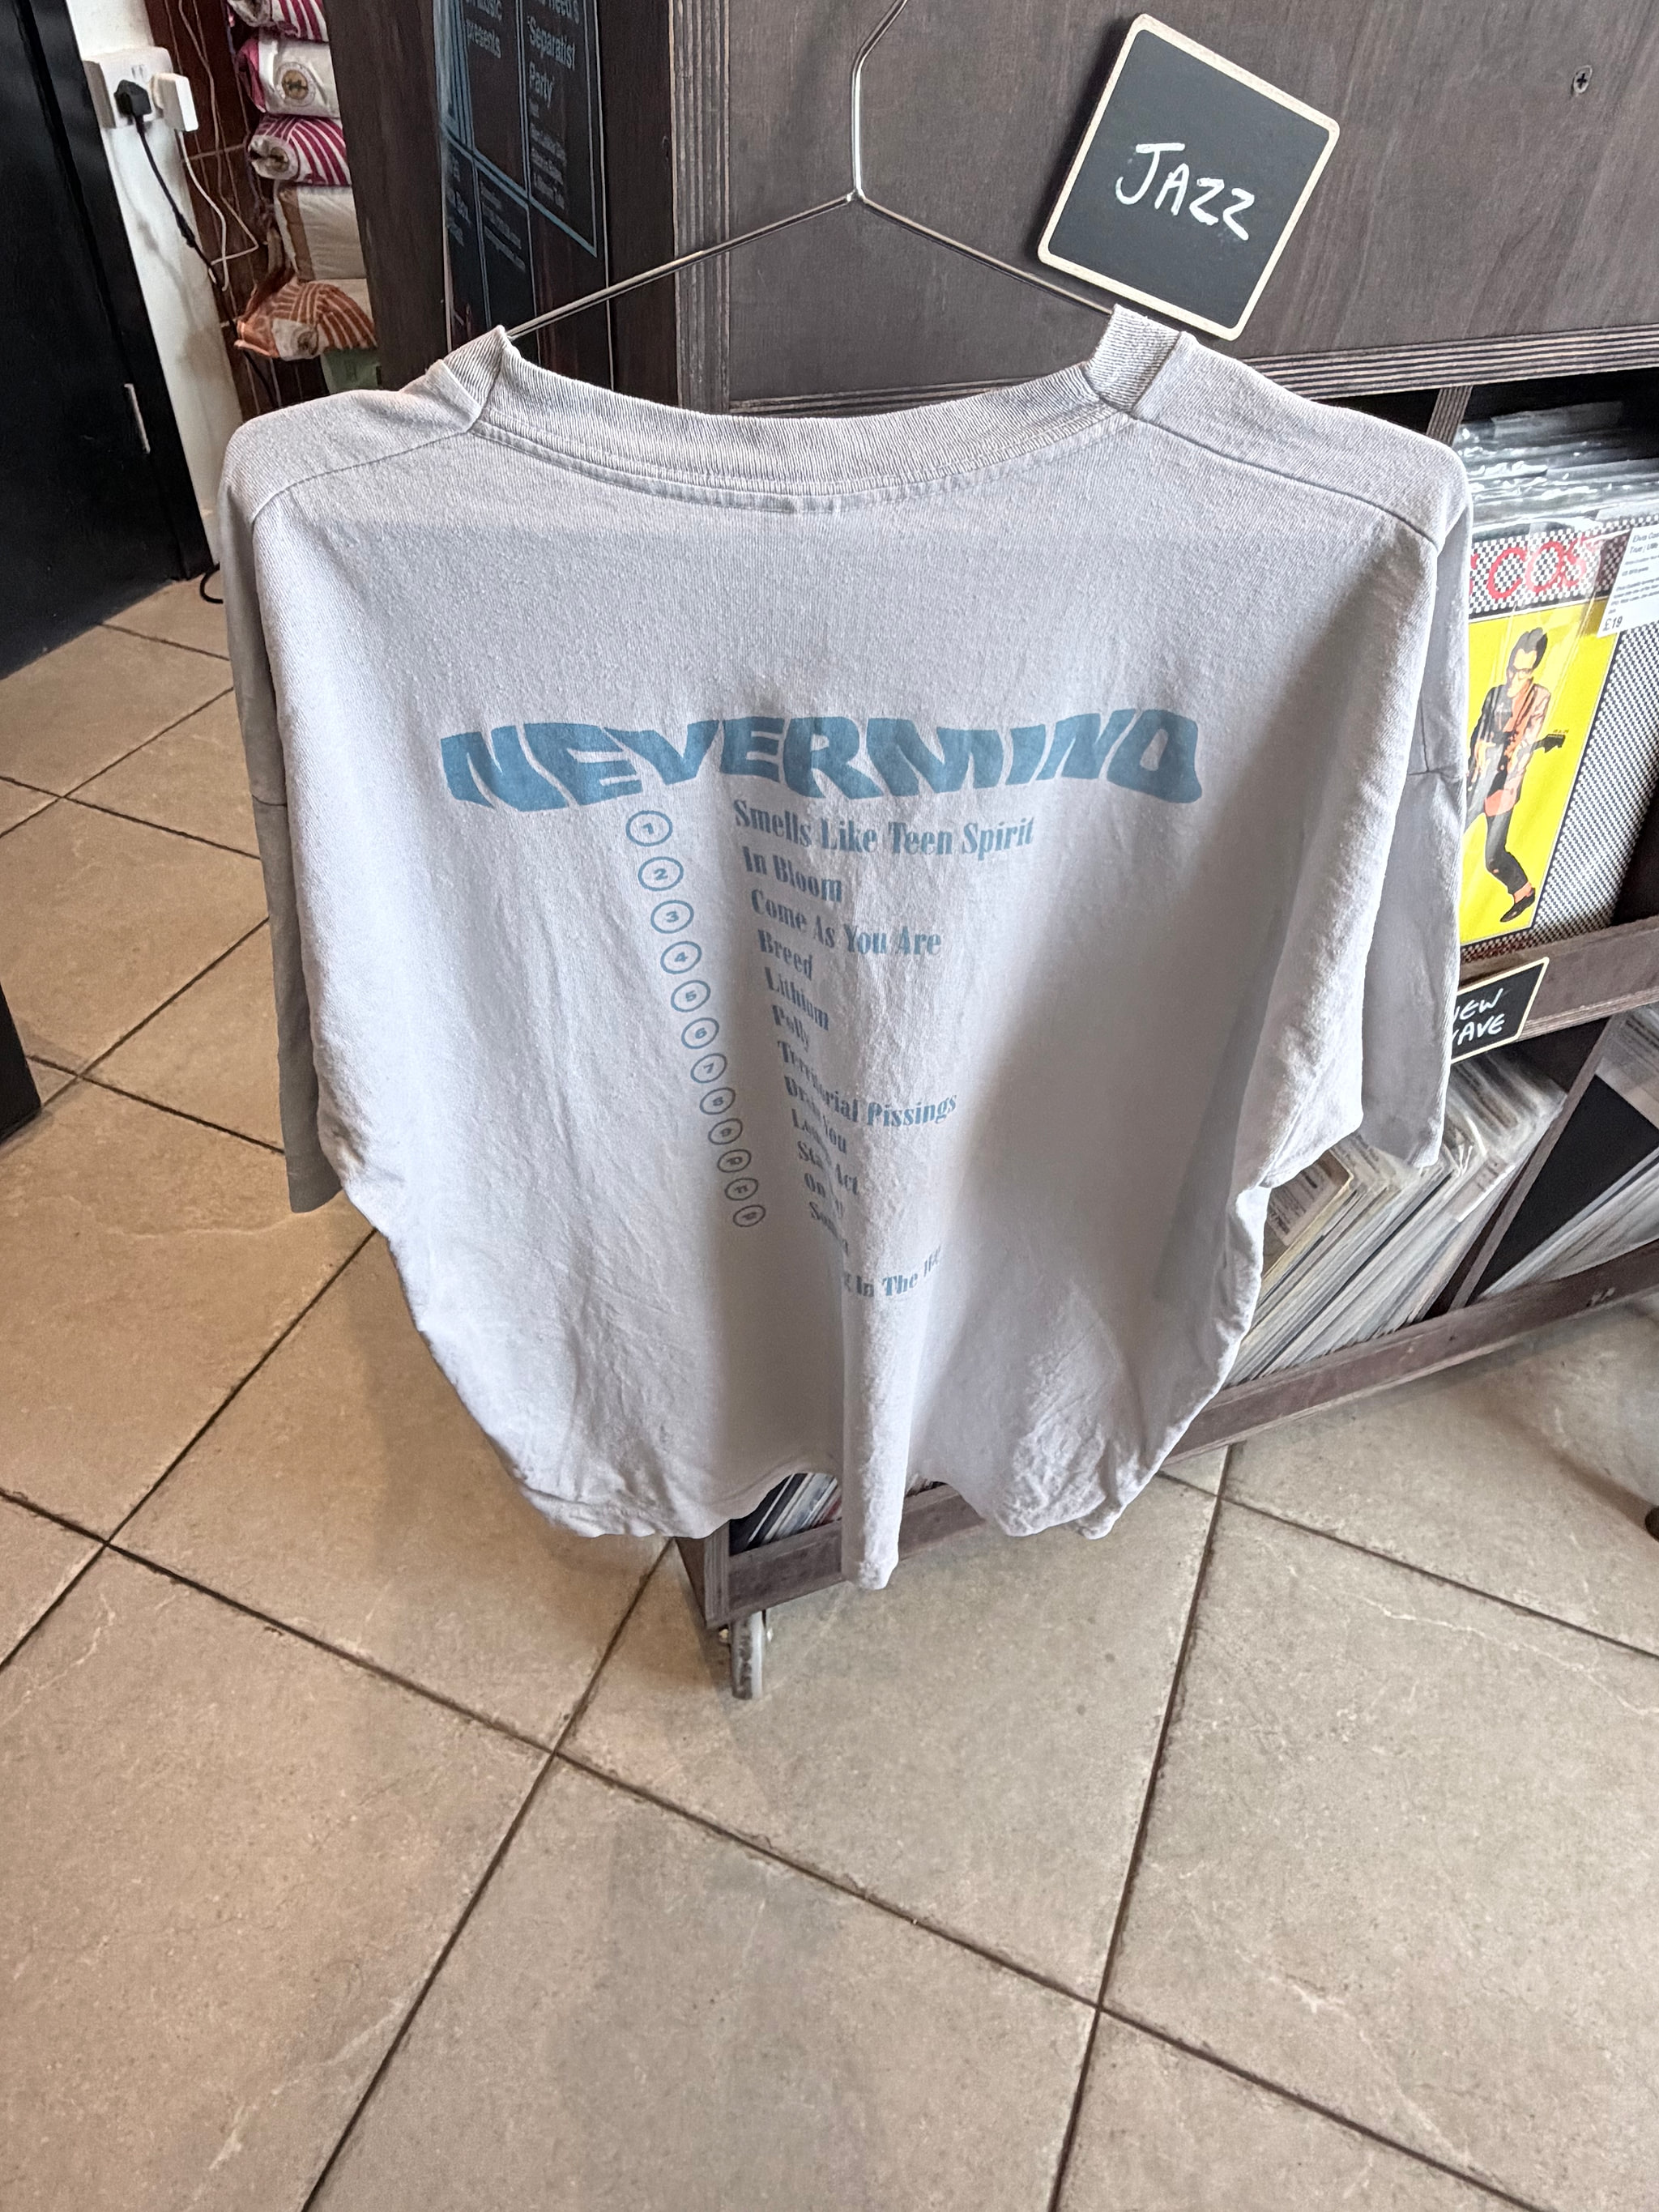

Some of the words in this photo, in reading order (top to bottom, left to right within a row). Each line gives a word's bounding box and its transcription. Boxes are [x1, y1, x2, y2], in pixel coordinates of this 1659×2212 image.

[1115, 143, 1255, 241] JAZZ
[440, 708, 1203, 812] NEVERMIND
[733, 798, 812, 848] Smells
[820, 817, 878, 853] Like
[887, 820, 954, 856] Teen
[961, 816, 1034, 862] Spirit
[741, 845, 768, 876] In
[772, 854, 843, 904] Bloom
[750, 888, 808, 933] Come
[813, 914, 836, 949] As
[842, 923, 888, 955] You
[898, 925, 942, 956] Are
[757, 928, 813, 982] Breed
[764, 965, 830, 1032] Lithium
[1452, 1013, 1506, 1046] AVE
[866, 1093, 957, 1127] Pissings
[881, 1272, 919, 1297] The
